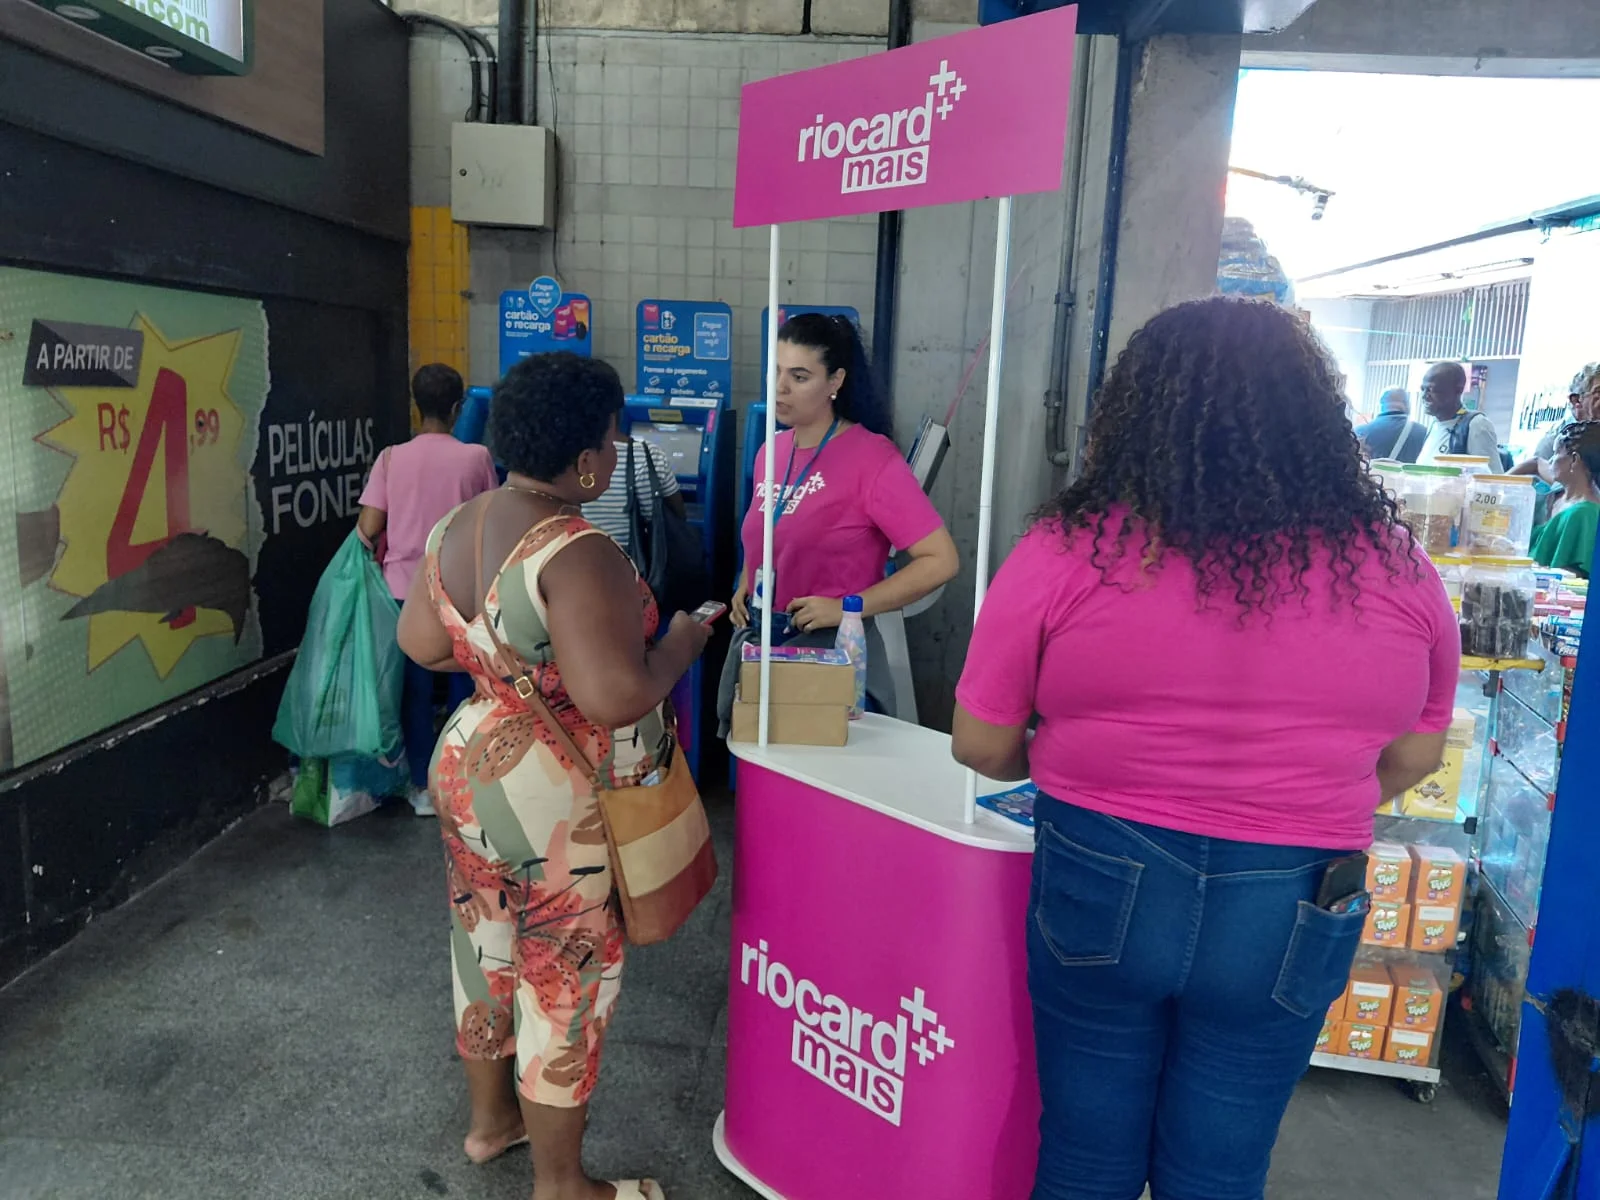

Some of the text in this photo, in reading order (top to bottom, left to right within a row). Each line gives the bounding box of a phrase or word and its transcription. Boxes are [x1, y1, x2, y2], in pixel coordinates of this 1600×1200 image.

[798, 92, 934, 162] riocard
[846, 151, 924, 188] mais
[505, 310, 539, 321] cartão
[514, 320, 551, 333] recarga
[36, 342, 134, 370] A PARTIR DE
[643, 333, 678, 344] cartão
[643, 344, 691, 356] e recarga
[97, 402, 131, 455] R$
[268, 409, 374, 478] PELÍCULAS
[272, 472, 370, 534] FONE
[1475, 493, 1497, 505] 2,00
[741, 939, 907, 1077] riocard
[799, 1030, 896, 1114] mais
